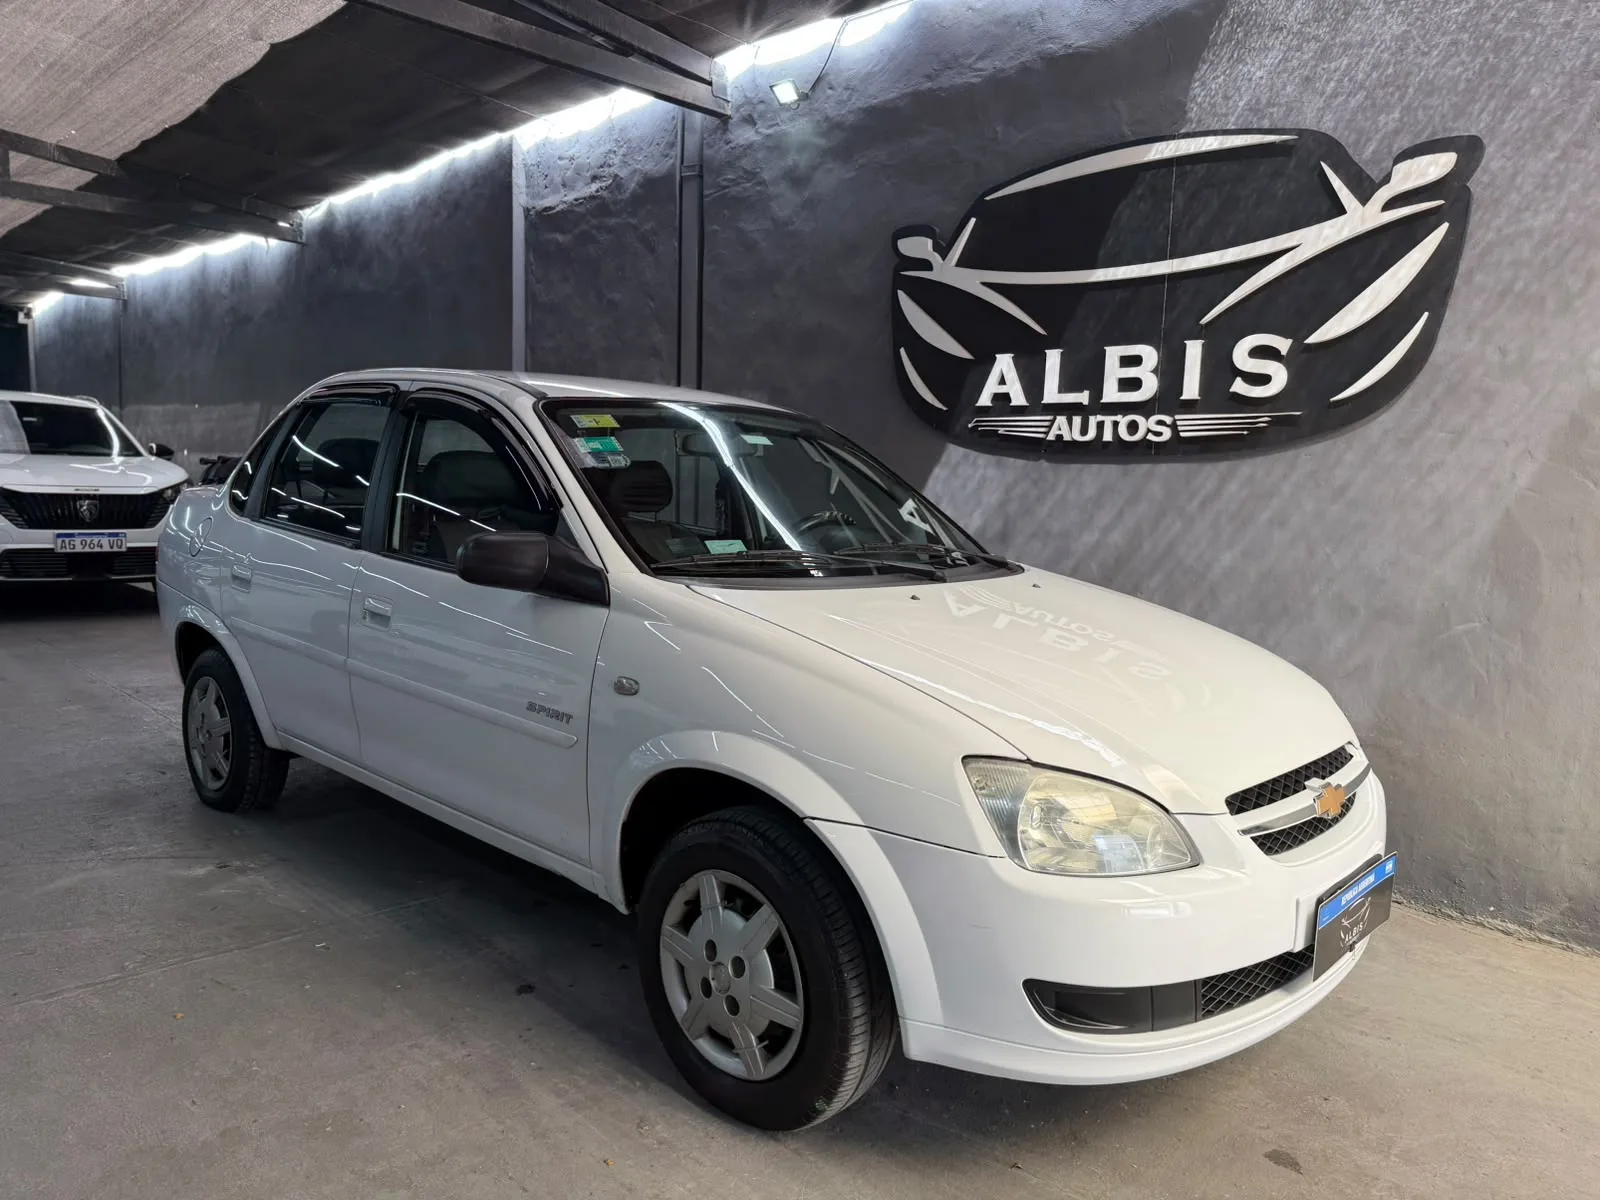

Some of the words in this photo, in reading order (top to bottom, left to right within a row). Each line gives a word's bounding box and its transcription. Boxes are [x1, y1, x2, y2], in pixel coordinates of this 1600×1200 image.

[975, 333, 1293, 407] ALBIS
[1046, 413, 1173, 442] AUTOS
[60, 538, 76, 550] AG
[80, 538, 104, 550] 964
[108, 538, 124, 550] VQ
[526, 701, 574, 725] SPIRIT
[1344, 921, 1364, 944] ALBIS
